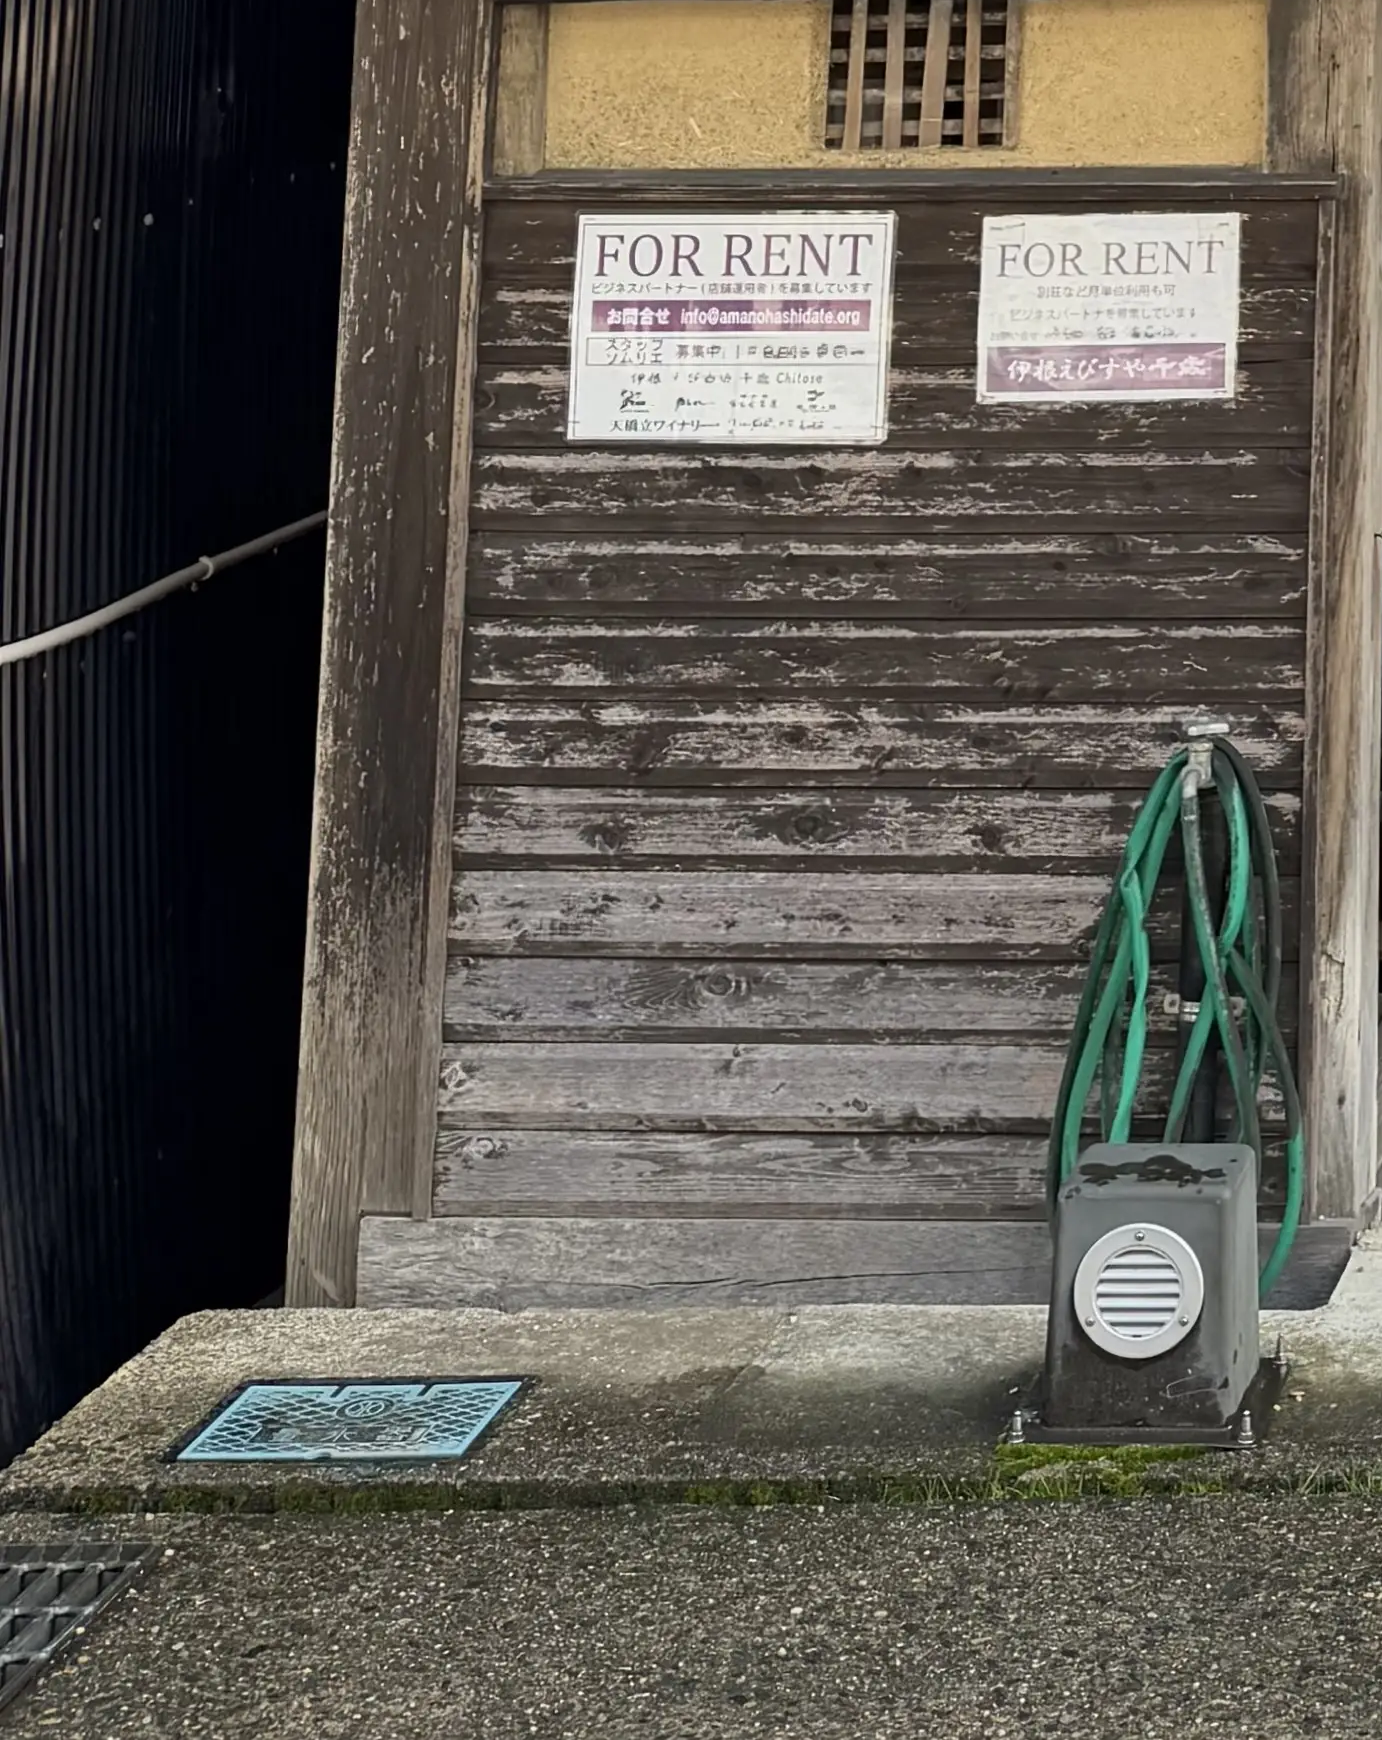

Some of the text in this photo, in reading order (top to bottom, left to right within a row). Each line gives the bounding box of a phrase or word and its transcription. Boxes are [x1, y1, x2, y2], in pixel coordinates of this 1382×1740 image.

[594, 233, 874, 277] FOR RENT
[996, 239, 1225, 278] FOR RENT
[606, 306, 861, 326] お問合せ info@amanohashidate.org
